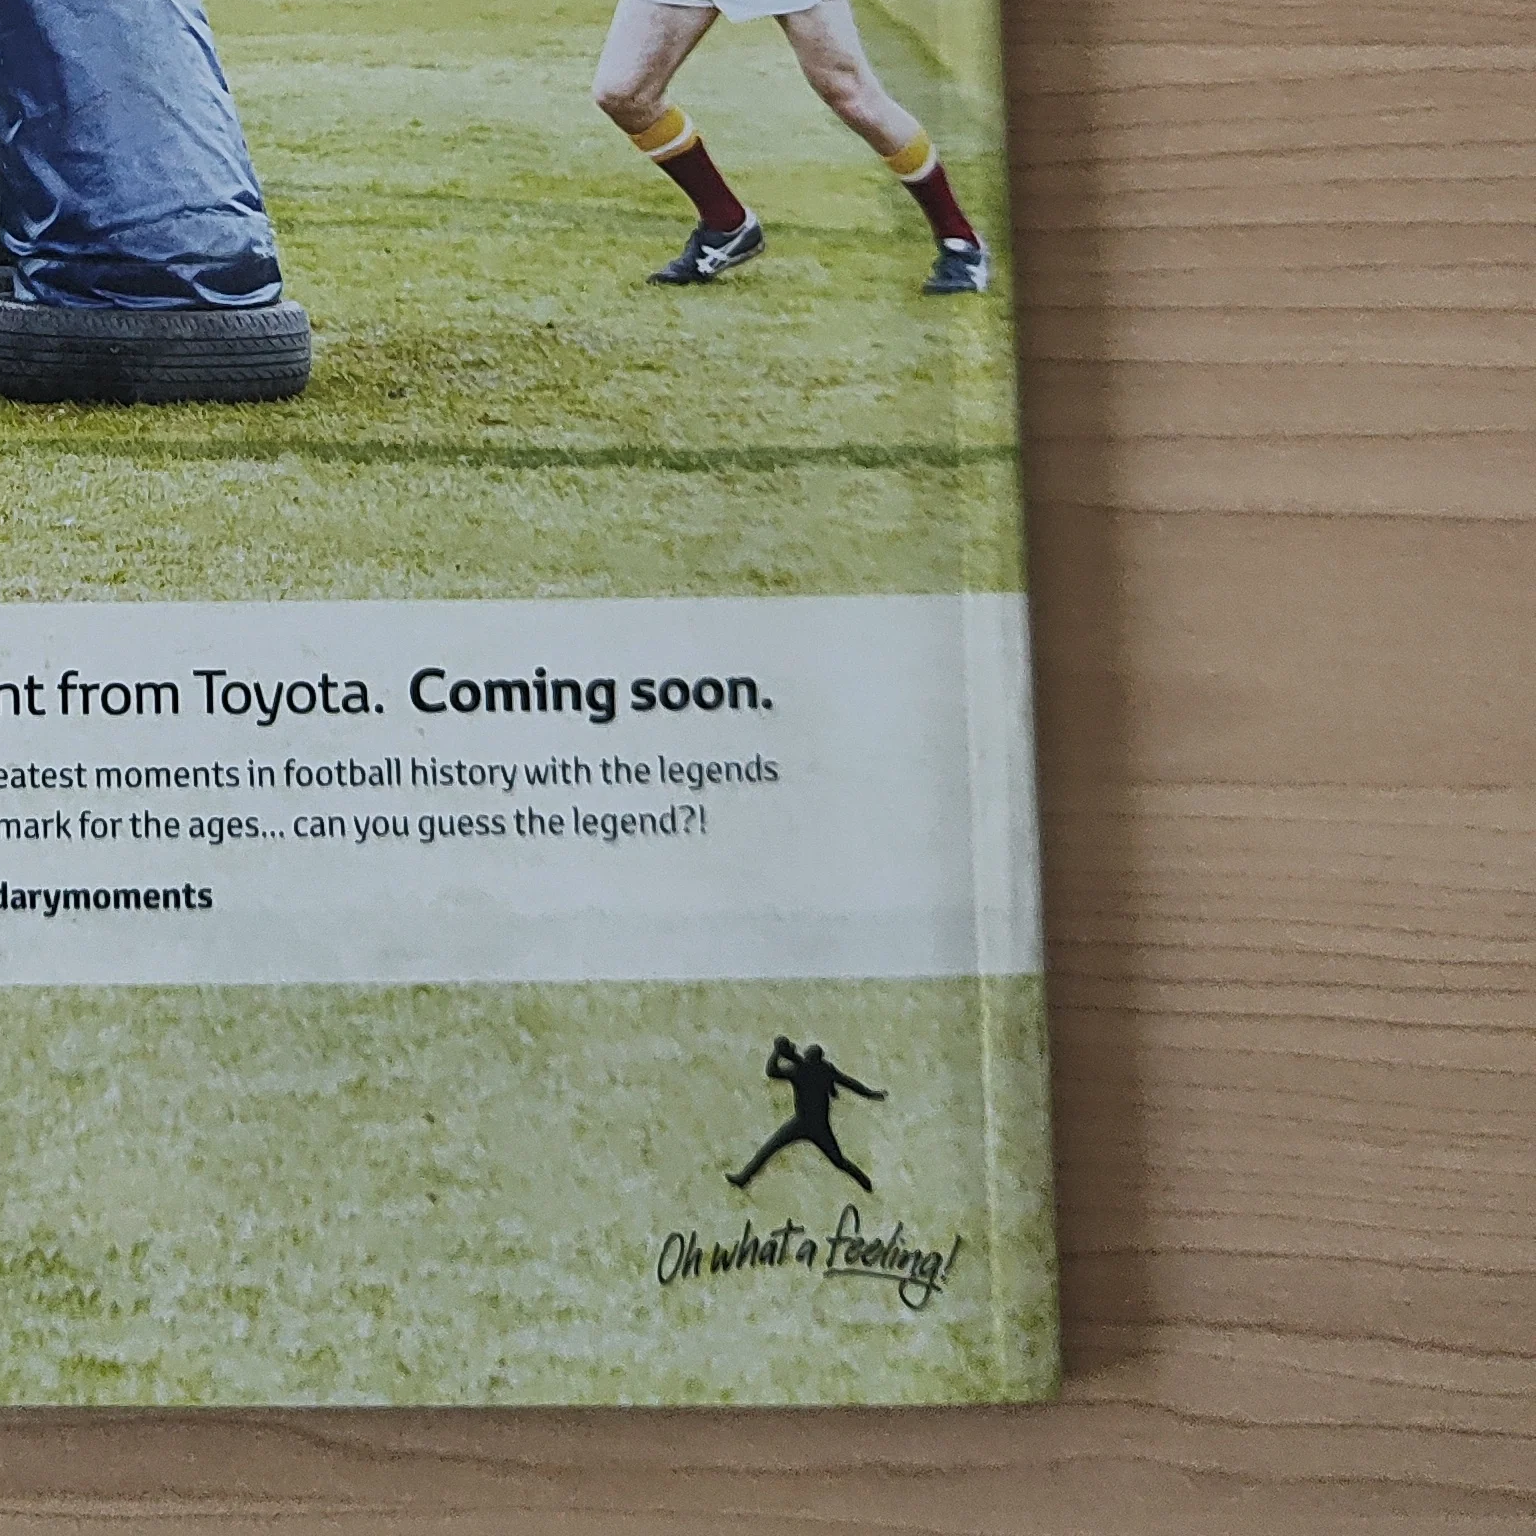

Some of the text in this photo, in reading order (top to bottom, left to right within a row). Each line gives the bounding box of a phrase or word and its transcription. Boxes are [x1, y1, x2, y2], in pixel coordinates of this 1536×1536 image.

[56, 669, 179, 716] from
[192, 669, 384, 728] Toyota.
[409, 666, 617, 725] Coming
[630, 676, 773, 713] soon.
[95, 761, 240, 790] moments
[247, 758, 275, 788] in
[283, 757, 401, 788] football
[411, 757, 518, 793] history
[524, 756, 592, 786] with
[601, 755, 651, 786] the
[657, 754, 779, 791] legends
[78, 810, 123, 840] for
[128, 809, 180, 840] the
[188, 816, 285, 846] ages...
[293, 816, 346, 838] can
[353, 815, 410, 845] you
[418, 814, 506, 844] guess
[515, 805, 565, 837] the
[572, 804, 706, 843] legend?!
[658, 1203, 963, 1311] Oh what a feeling!
